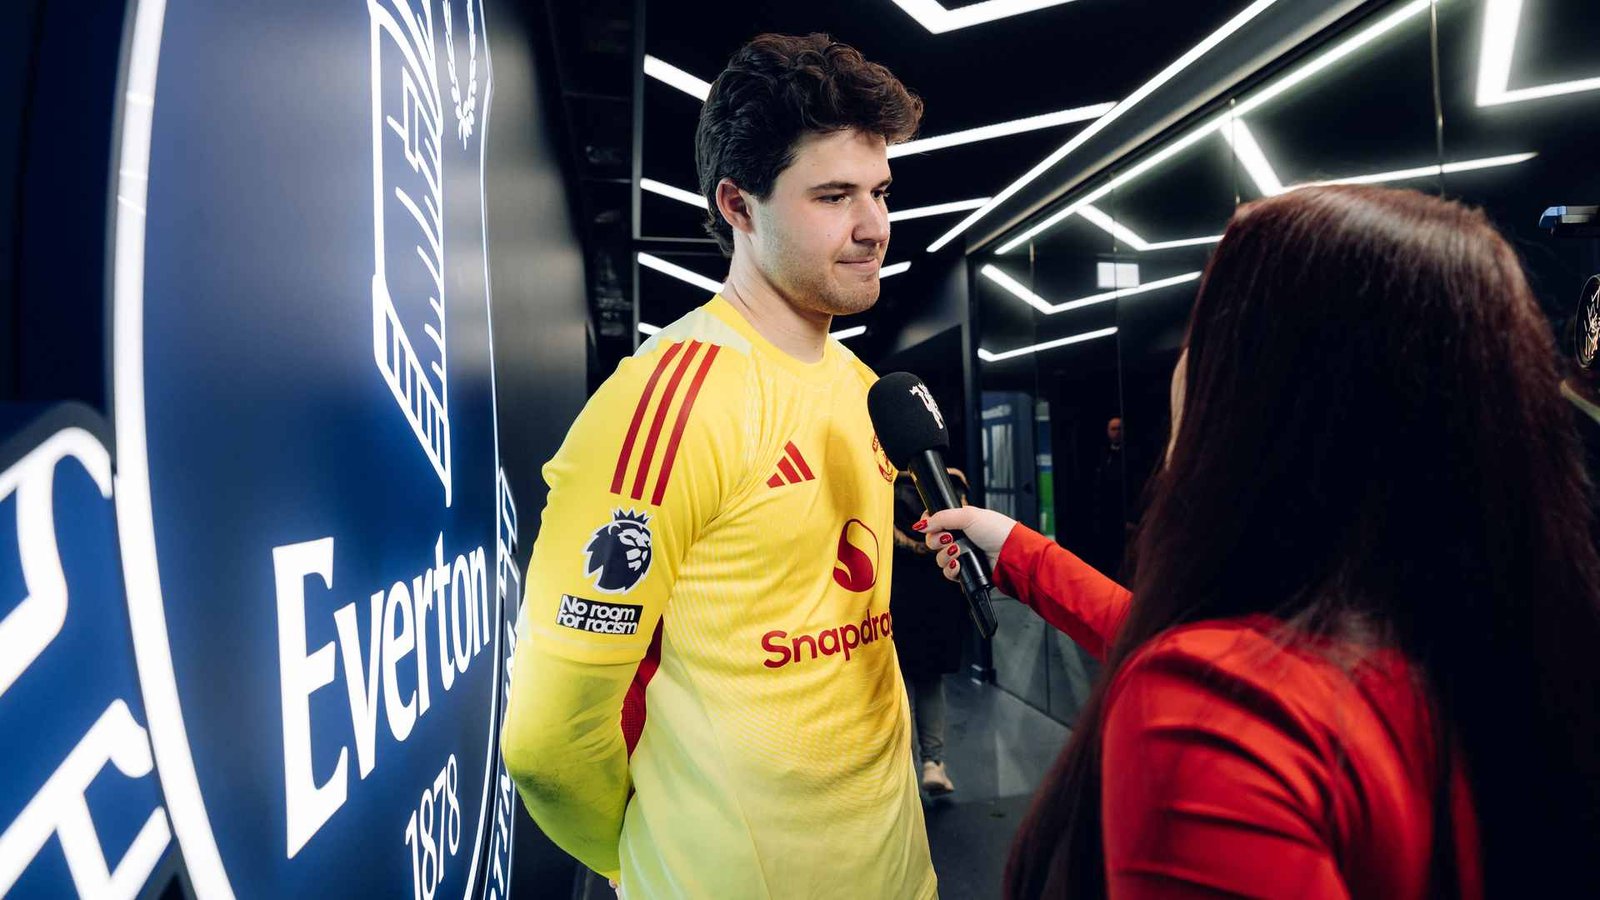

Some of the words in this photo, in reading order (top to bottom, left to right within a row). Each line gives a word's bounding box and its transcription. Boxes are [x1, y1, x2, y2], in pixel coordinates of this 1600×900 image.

[557, 609, 584, 629] for
[584, 617, 638, 634] racism
[560, 594, 588, 615] No
[589, 604, 636, 621] room
[761, 608, 892, 668] Snapdra
[272, 530, 490, 860] Everton
[405, 753, 460, 900] 1878
